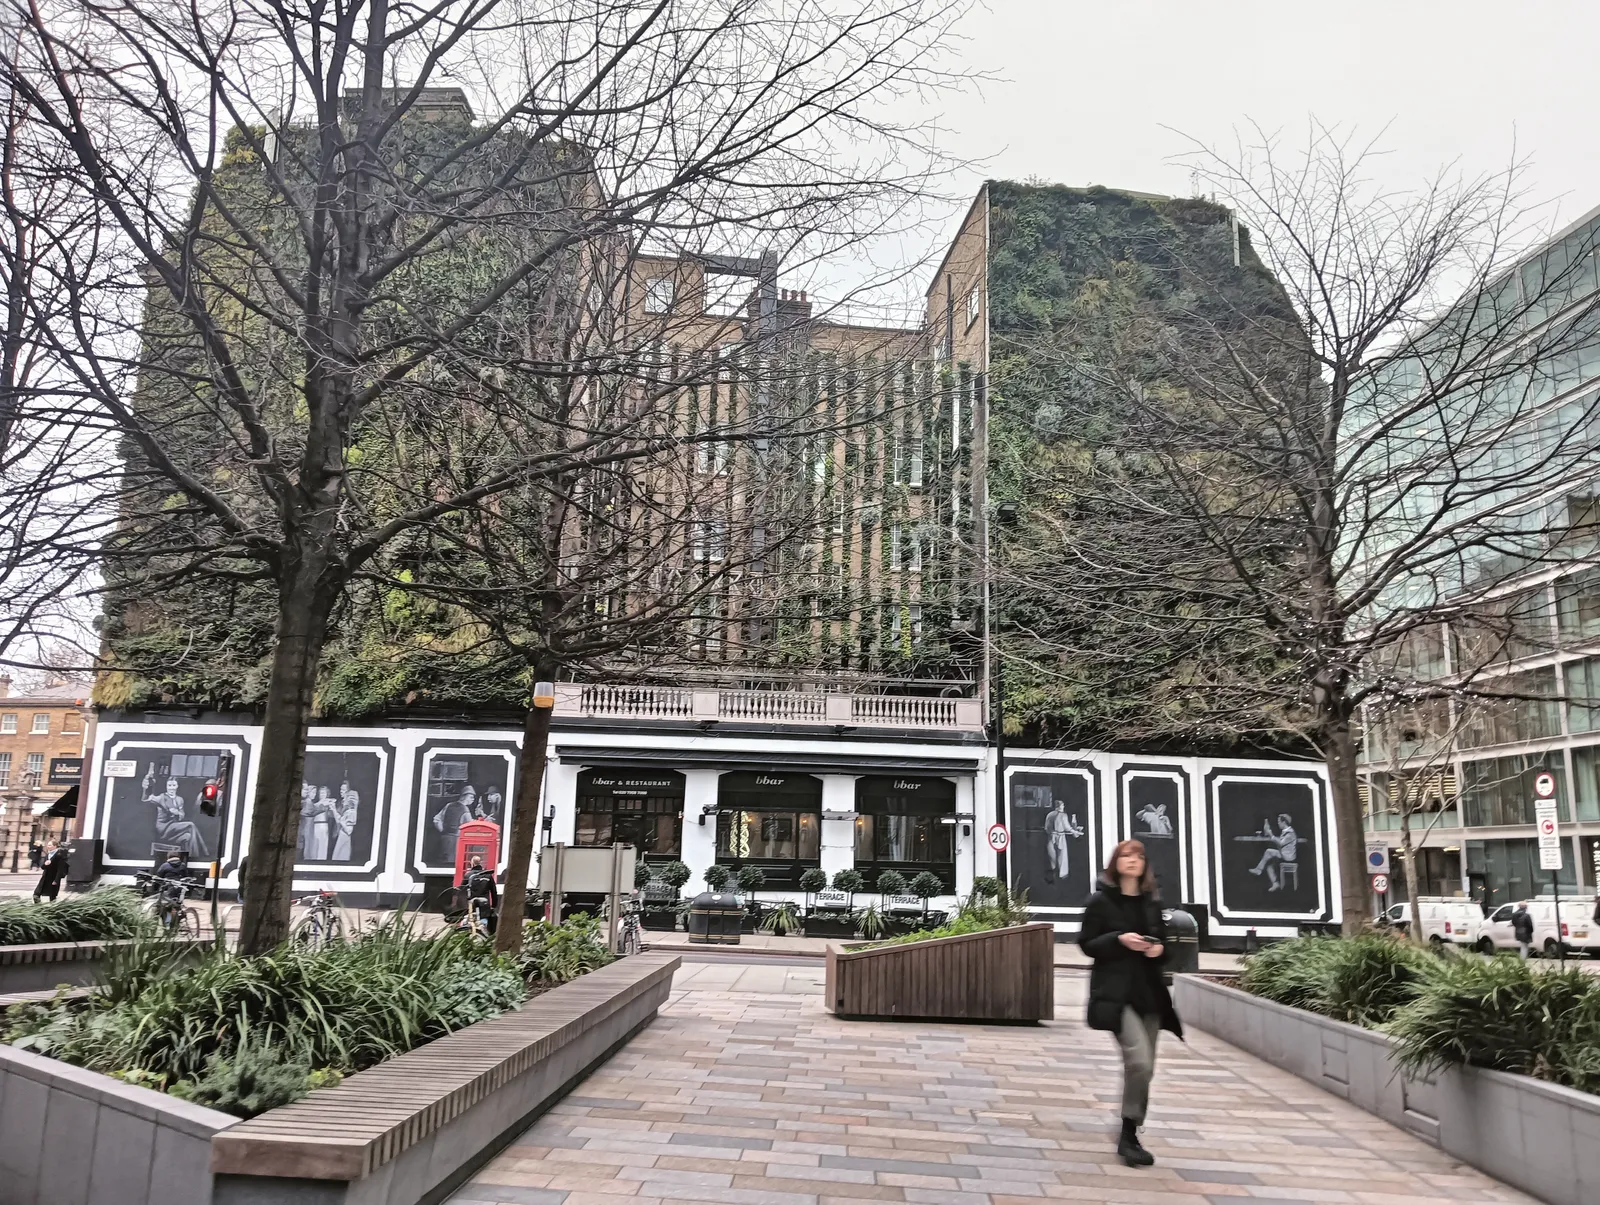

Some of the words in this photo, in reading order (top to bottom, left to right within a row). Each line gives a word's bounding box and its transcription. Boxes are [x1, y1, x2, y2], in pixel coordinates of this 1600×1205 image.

[592, 777, 615, 785] bbar
[755, 776, 785, 785] bbar
[893, 780, 921, 789] bbar
[991, 832, 1006, 844] 20
[1374, 878, 1387, 888] 20
[816, 892, 845, 901] TERRACE
[890, 895, 920, 905] TERRACE
